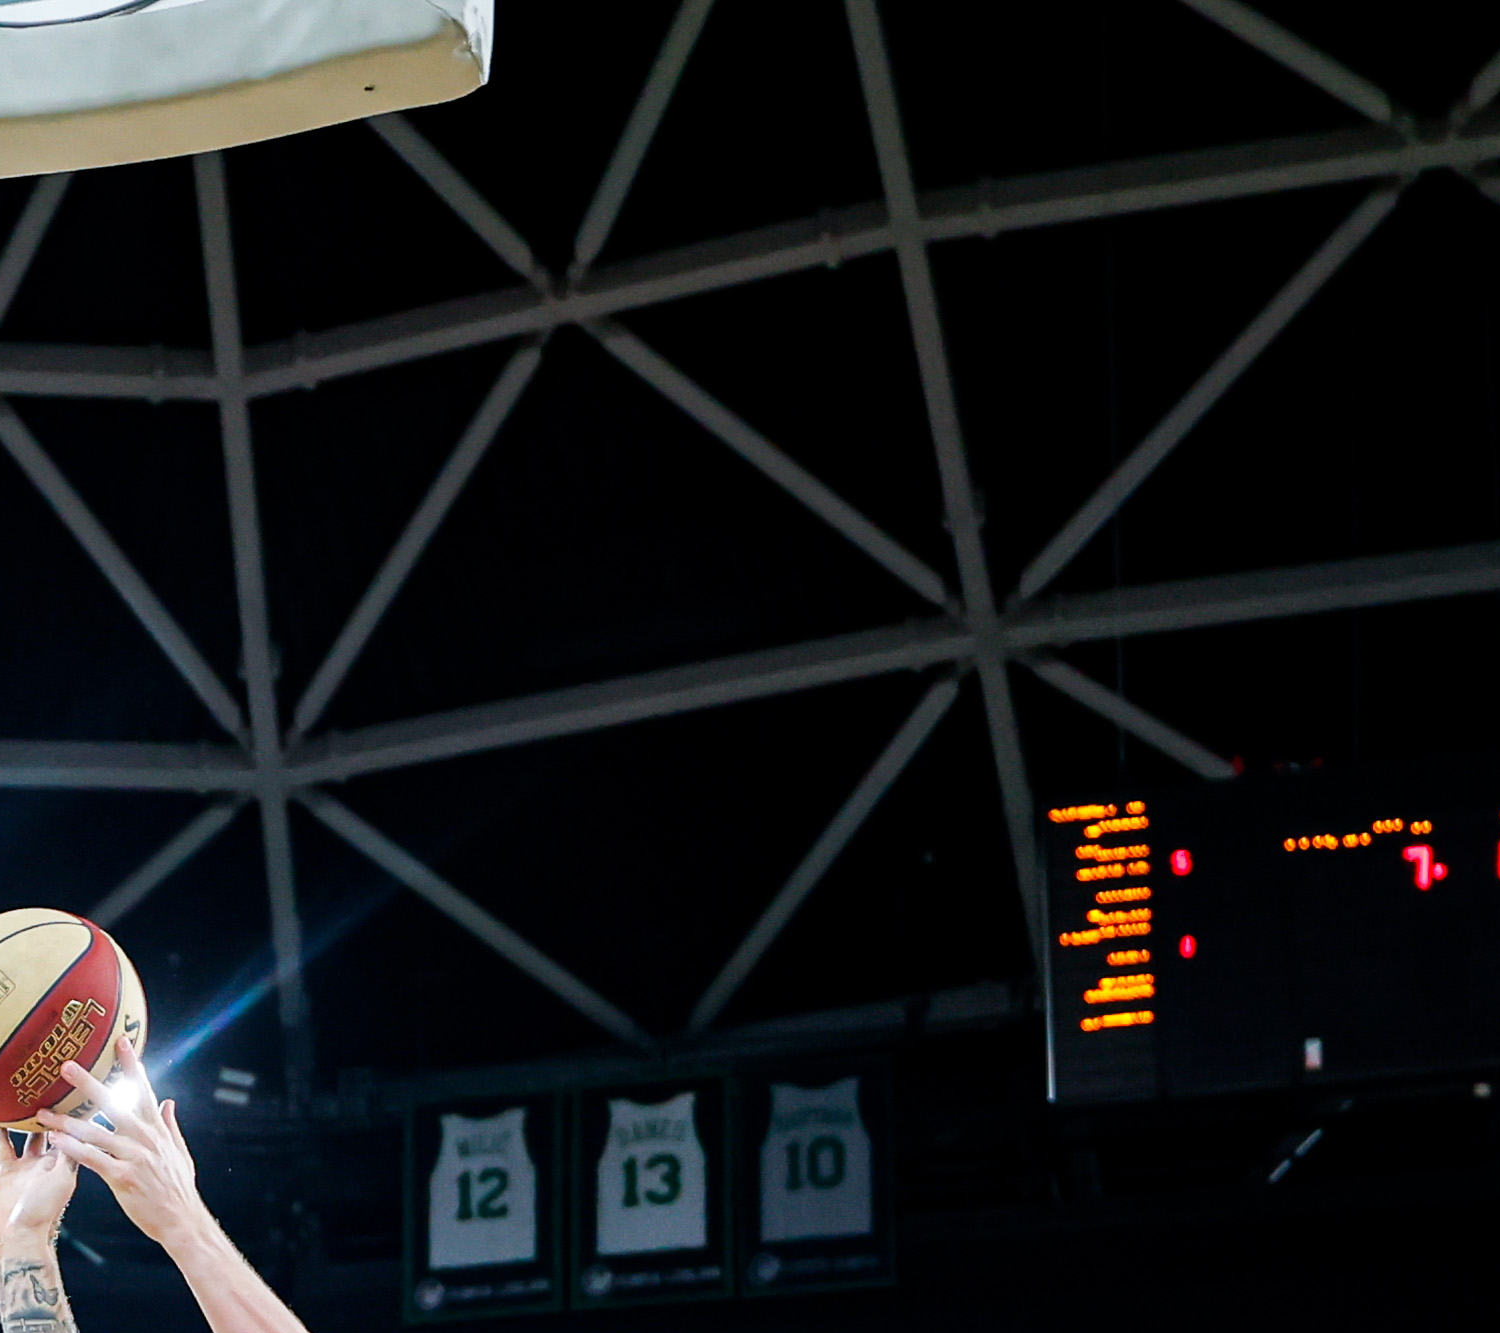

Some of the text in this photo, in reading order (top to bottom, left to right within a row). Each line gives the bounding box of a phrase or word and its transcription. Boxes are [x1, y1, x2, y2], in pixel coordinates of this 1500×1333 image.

[620, 1153, 684, 1209] 13
[783, 1135, 848, 1192] 10
[455, 1167, 511, 1223] 12
